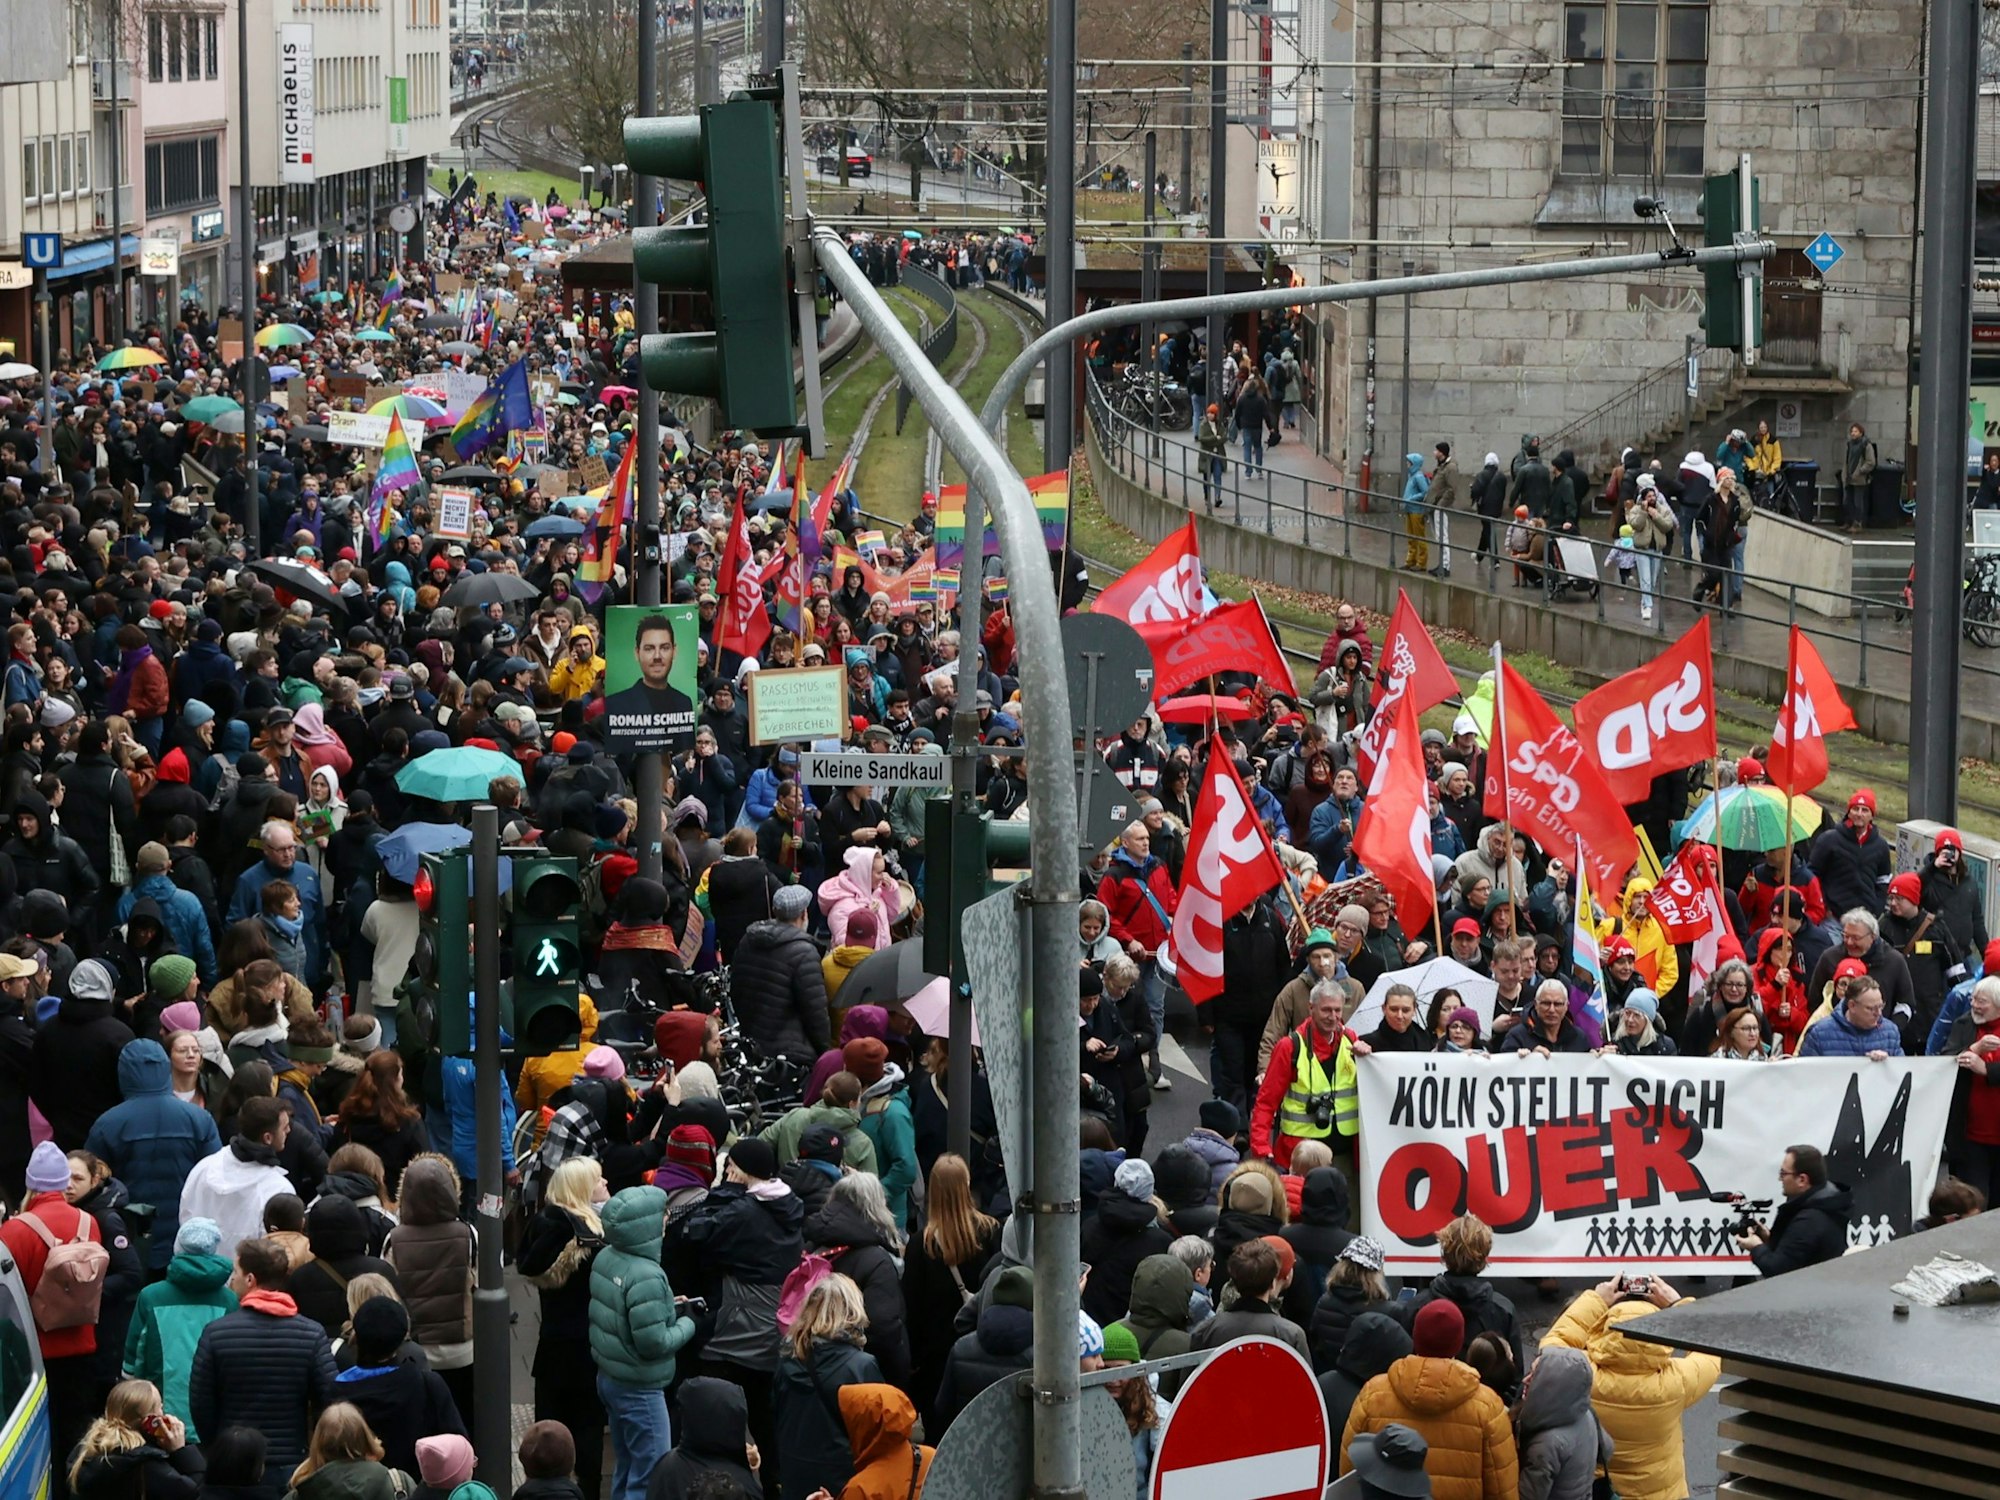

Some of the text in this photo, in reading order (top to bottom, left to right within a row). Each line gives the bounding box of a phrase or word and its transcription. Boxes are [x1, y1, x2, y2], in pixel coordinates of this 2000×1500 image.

[1260, 144, 1297, 158] BALLETT
[1259, 205, 1296, 215] JAZZ
[30, 238, 54, 264] U
[761, 681, 820, 697] RASSISMUS
[609, 711, 696, 727] ROMAN SCHULTE
[764, 718, 834, 735] VERBRECHEN
[812, 759, 943, 780] Kleine Sandkaul
[1509, 740, 1581, 813] SPD
[1389, 1063, 1725, 1129] KÖLN STELLT SICH
[1377, 1105, 1711, 1248] QUER
